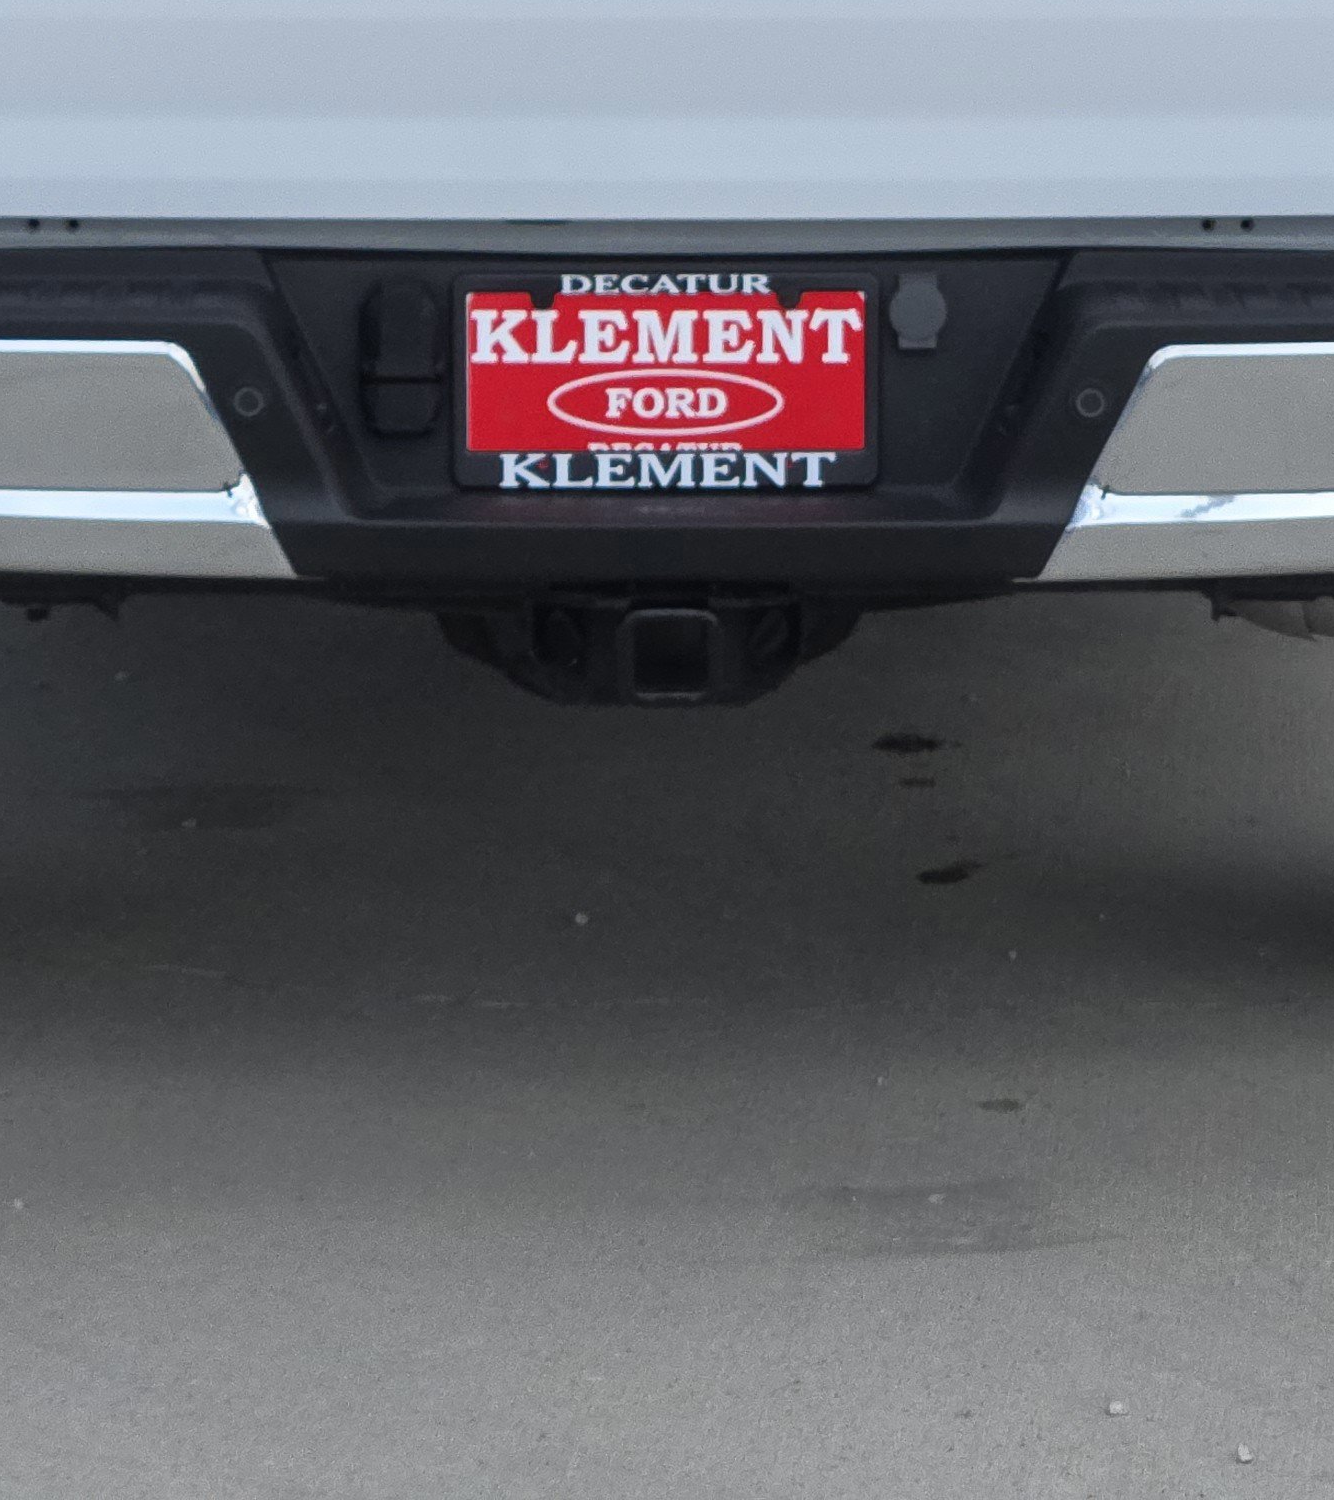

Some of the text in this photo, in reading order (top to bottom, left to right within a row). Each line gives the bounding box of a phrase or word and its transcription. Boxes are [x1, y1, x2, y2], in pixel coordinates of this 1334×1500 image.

[561, 274, 772, 295] DECATUR
[470, 309, 862, 364] KLEMENT
[604, 387, 728, 418] FORD
[499, 452, 837, 488] KLEMENT
